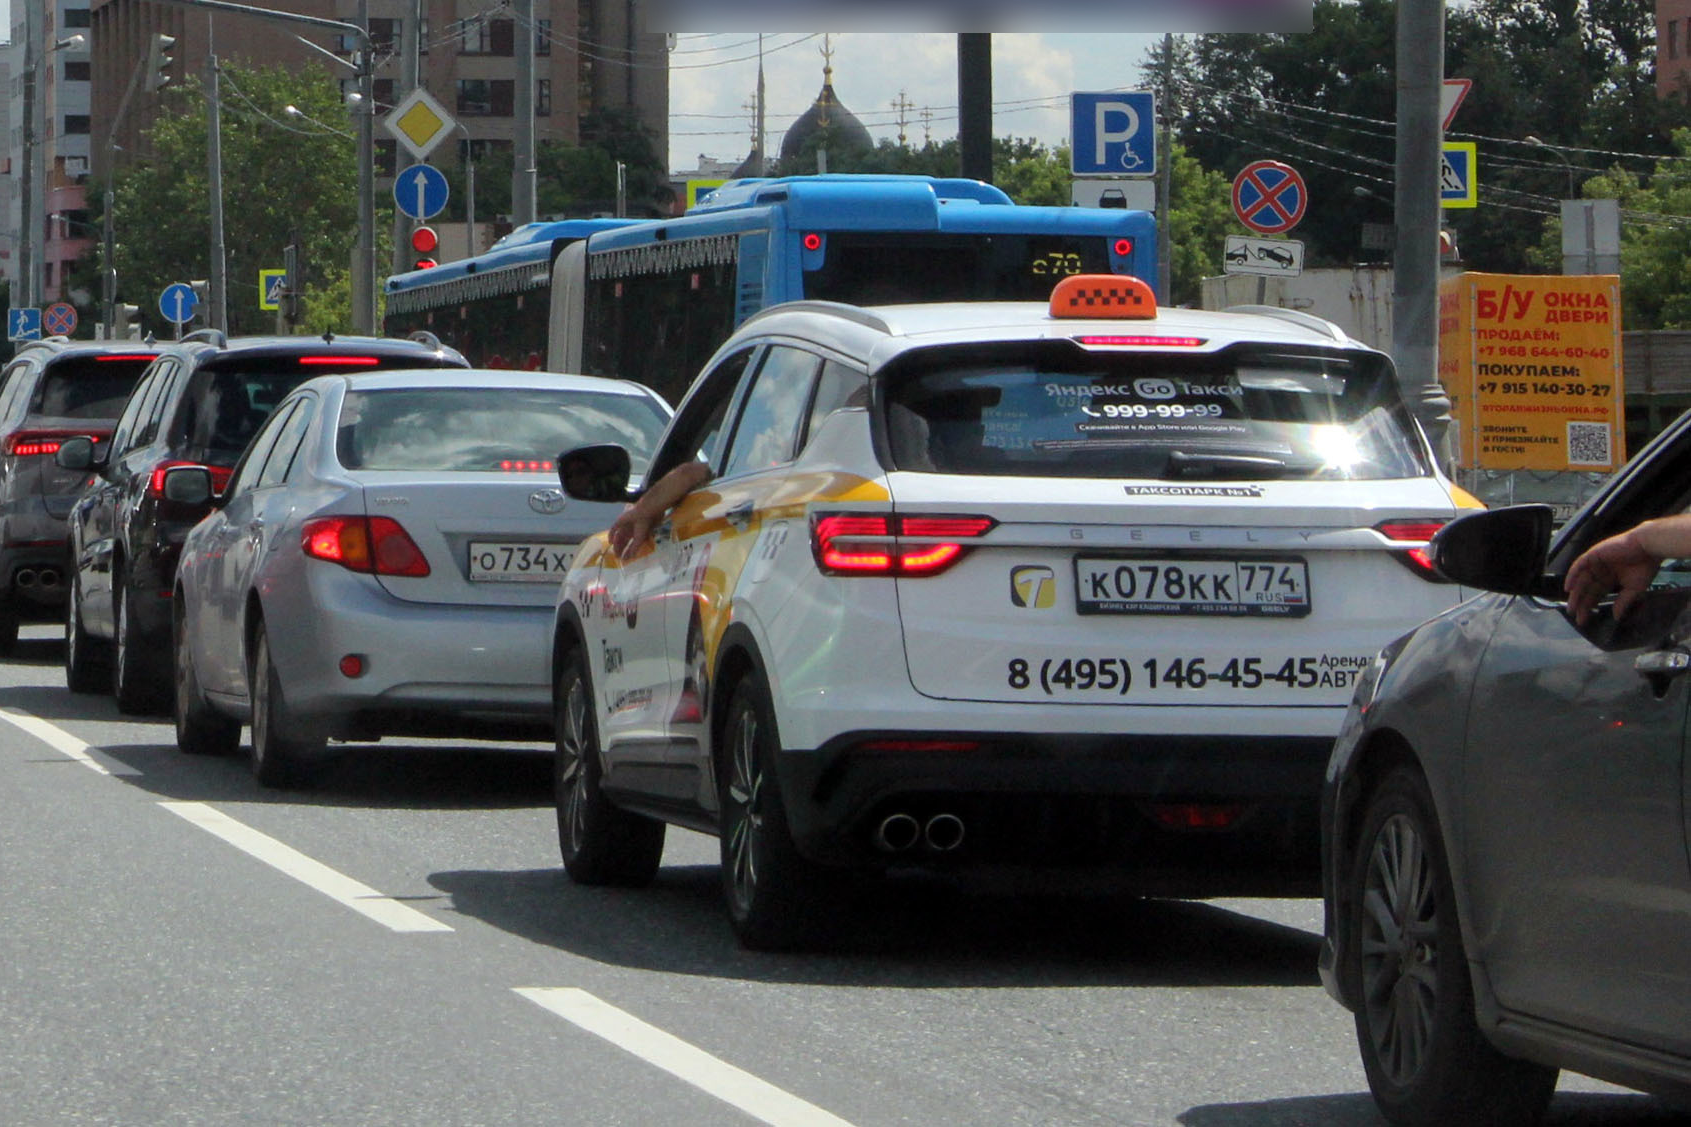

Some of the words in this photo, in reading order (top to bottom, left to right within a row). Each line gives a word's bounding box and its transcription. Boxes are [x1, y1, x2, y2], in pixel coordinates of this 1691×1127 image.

[1095, 101, 1139, 165] P
[1477, 284, 1535, 323] Б/У
[1544, 291, 1609, 308] ОКНА
[1544, 309, 1609, 324] ДВЕРИ
[1477, 328, 1560, 342] ПРОДАЁМ:
[1478, 345, 1494, 356] +7
[1499, 345, 1526, 358] 968
[1478, 363, 1581, 377] ПОКУПАЕМ:
[1045, 383, 1130, 398] Яндекс
[1181, 382, 1244, 397] Такси
[1478, 382, 1497, 395] +7
[1502, 382, 1528, 395] 915
[1533, 383, 1611, 397] 140-30-27
[1103, 404, 1223, 418] 999-99-99
[1138, 424, 1157, 433] App
[1157, 424, 1180, 432] Store
[1198, 424, 1227, 434] Google
[1228, 425, 1246, 434] Play
[1130, 486, 1224, 497] ТАКСОПАРК
[1069, 528, 1312, 543] GEELY
[480, 547, 574, 572] О734Х
[1239, 565, 1297, 592] 774
[1256, 592, 1283, 603] RUS
[1008, 658, 1030, 689] 8
[1040, 657, 1132, 694] (495)
[1143, 657, 1318, 689] 146-45-45
[1319, 671, 1355, 688] АВТ
